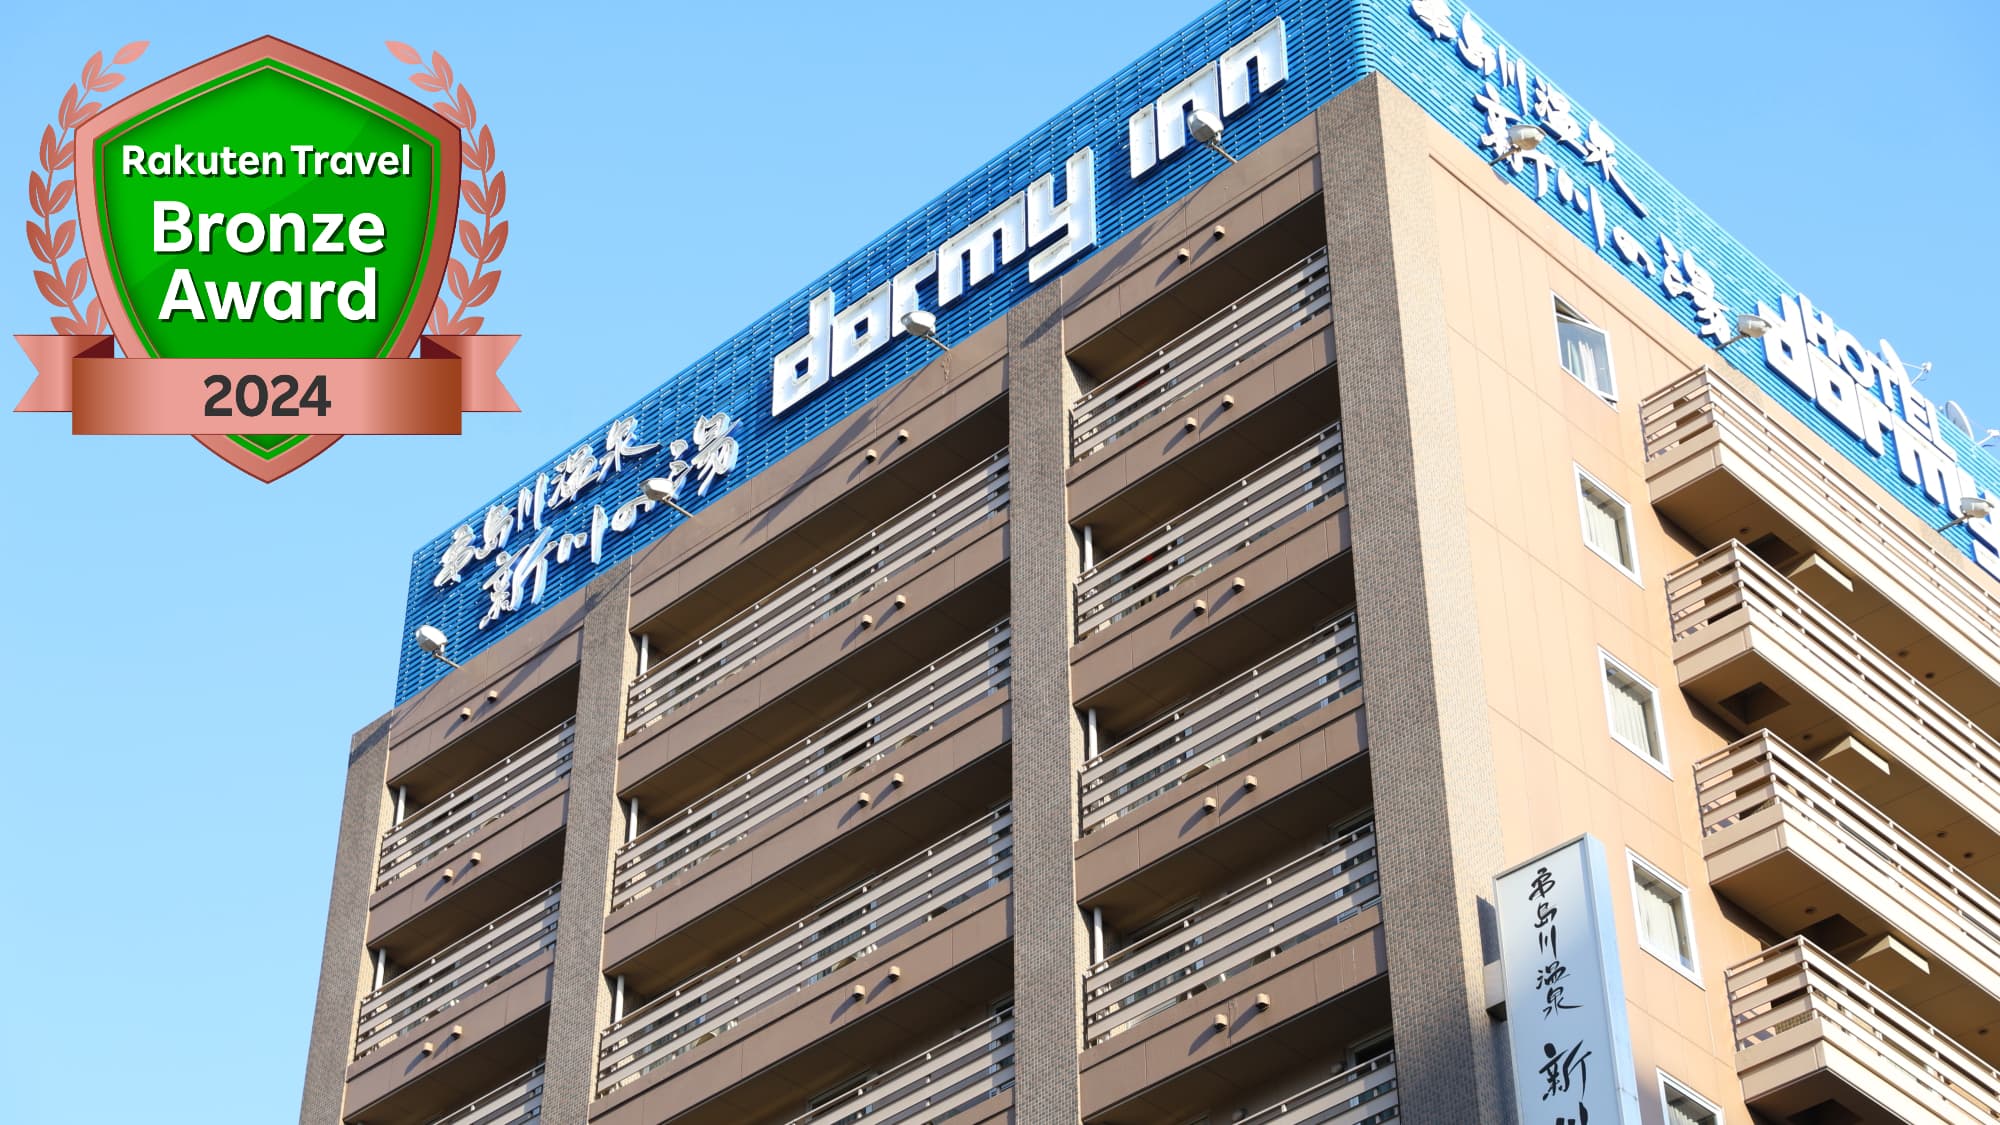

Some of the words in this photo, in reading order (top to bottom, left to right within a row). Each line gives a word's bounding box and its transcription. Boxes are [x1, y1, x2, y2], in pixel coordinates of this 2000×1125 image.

[771, 146, 1097, 418] dormy
[1129, 16, 1289, 179] inn
[1798, 292, 1957, 462] HOTEL
